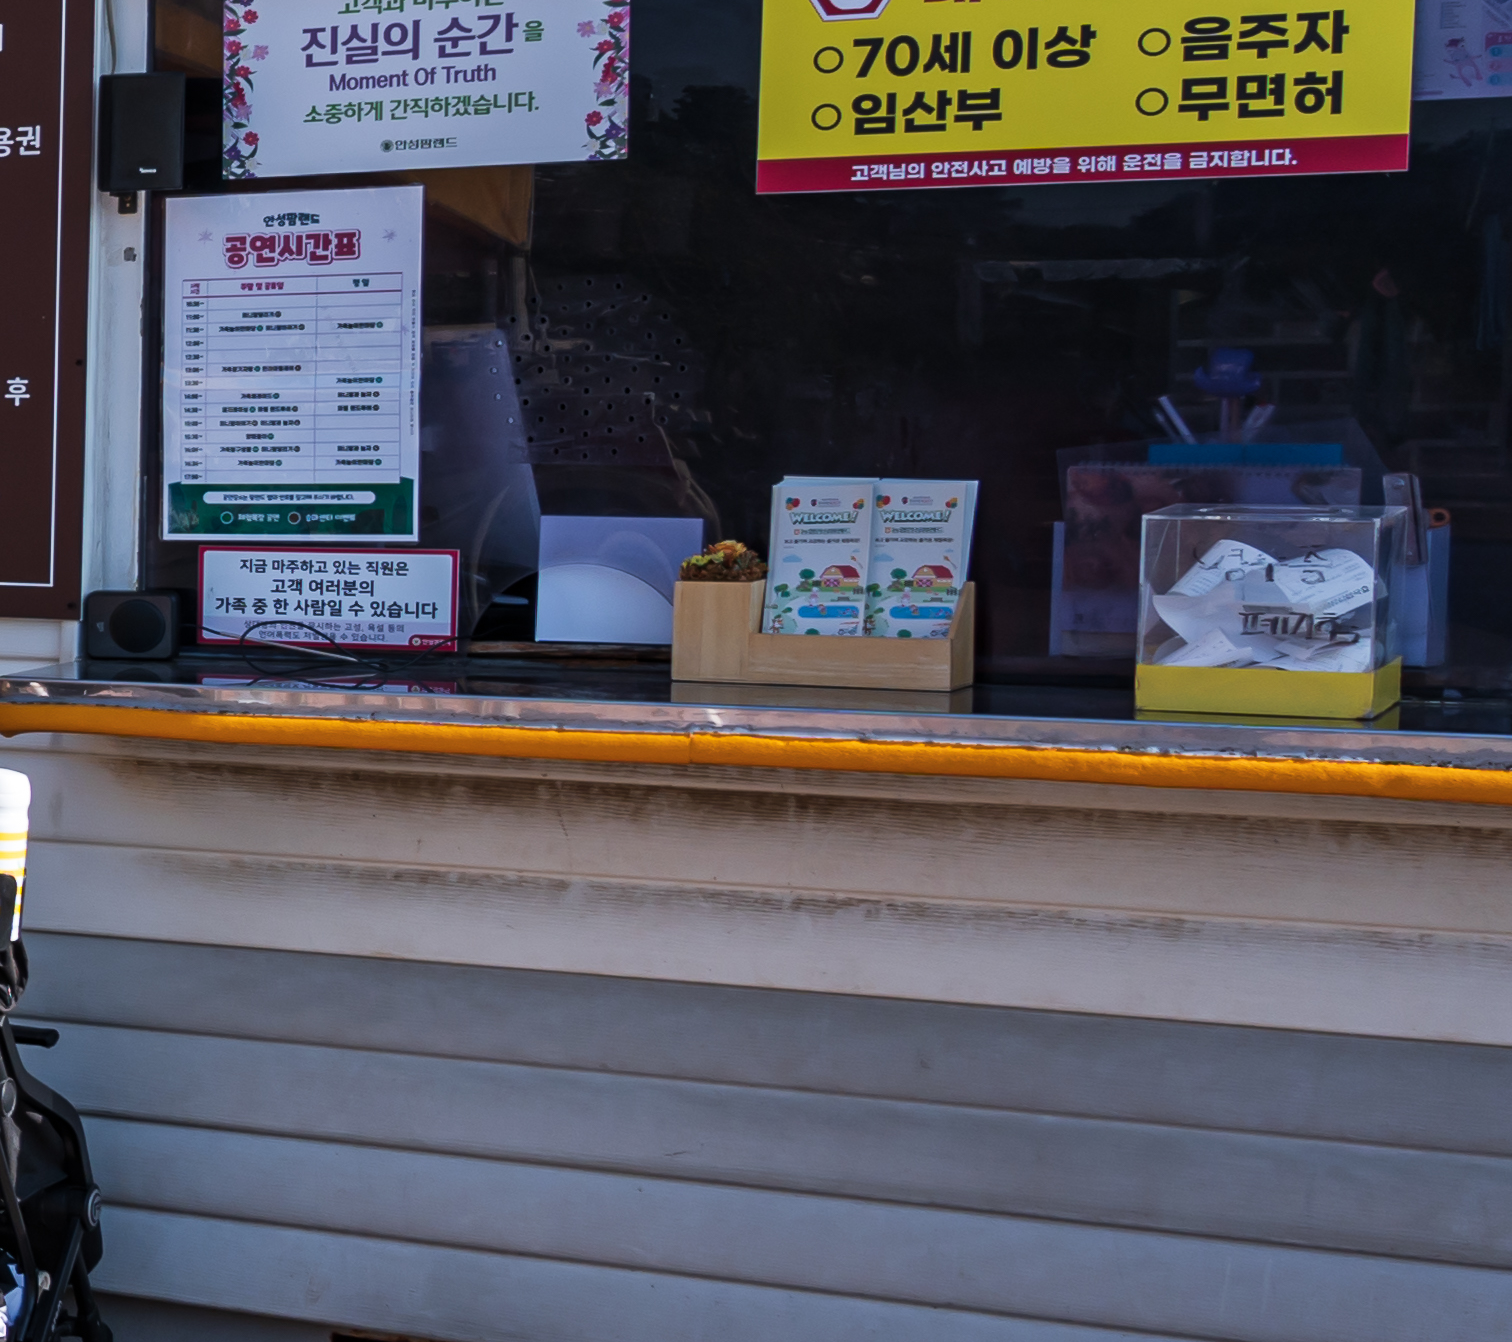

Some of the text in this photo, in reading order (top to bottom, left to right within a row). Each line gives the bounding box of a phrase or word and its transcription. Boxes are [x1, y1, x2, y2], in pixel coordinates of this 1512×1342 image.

[300, 13, 544, 68] 진실의 순간 을
[852, 24, 1097, 79] 70세 이상
[1180, 10, 1350, 62] 음주자
[329, 63, 496, 92] Moment Of Truth
[303, 91, 540, 125] 소중하게 간직하겠습니다.
[851, 87, 1004, 136] 임산부
[1177, 70, 1345, 121] 무면허
[850, 147, 1298, 182] 고객님의 안전사고 예방을 위해 운전을 금지합니다.
[223, 229, 361, 269] 공연시간표
[790, 511, 859, 524] WELCOME!
[880, 510, 951, 524] WELCOME!
[240, 559, 409, 576] 지금 마주하고 있는 직원은
[271, 579, 375, 597] 고객 여러분의
[215, 597, 438, 619] 가족 중 한 사람일 수 있습니다
